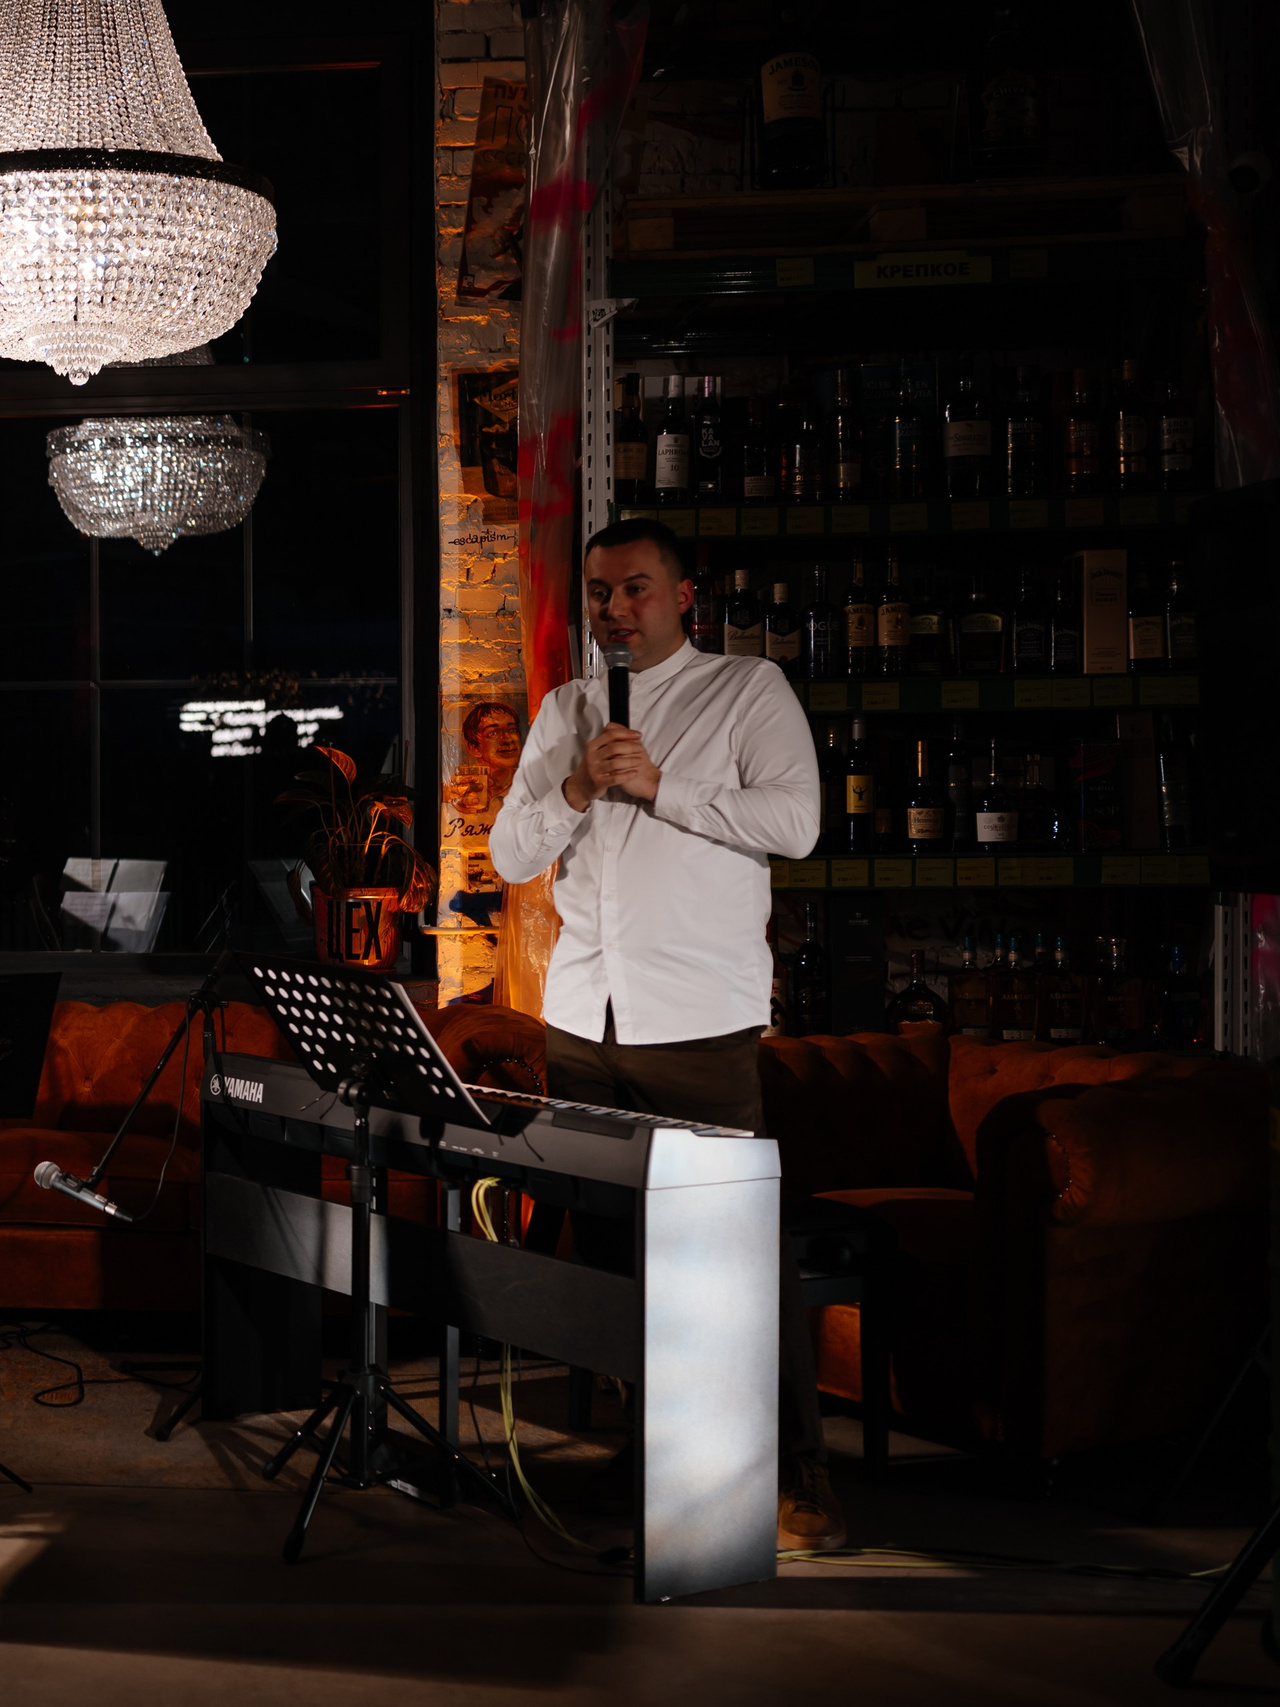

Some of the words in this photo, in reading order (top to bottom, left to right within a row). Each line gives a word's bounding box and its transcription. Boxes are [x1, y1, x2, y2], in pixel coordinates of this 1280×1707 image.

[992, 85, 1025, 98] CHIVA
[876, 262, 971, 280] КРЕПКОЕ
[327, 900, 382, 963] ЦЕХ
[223, 1075, 265, 1104] YAMAHA
